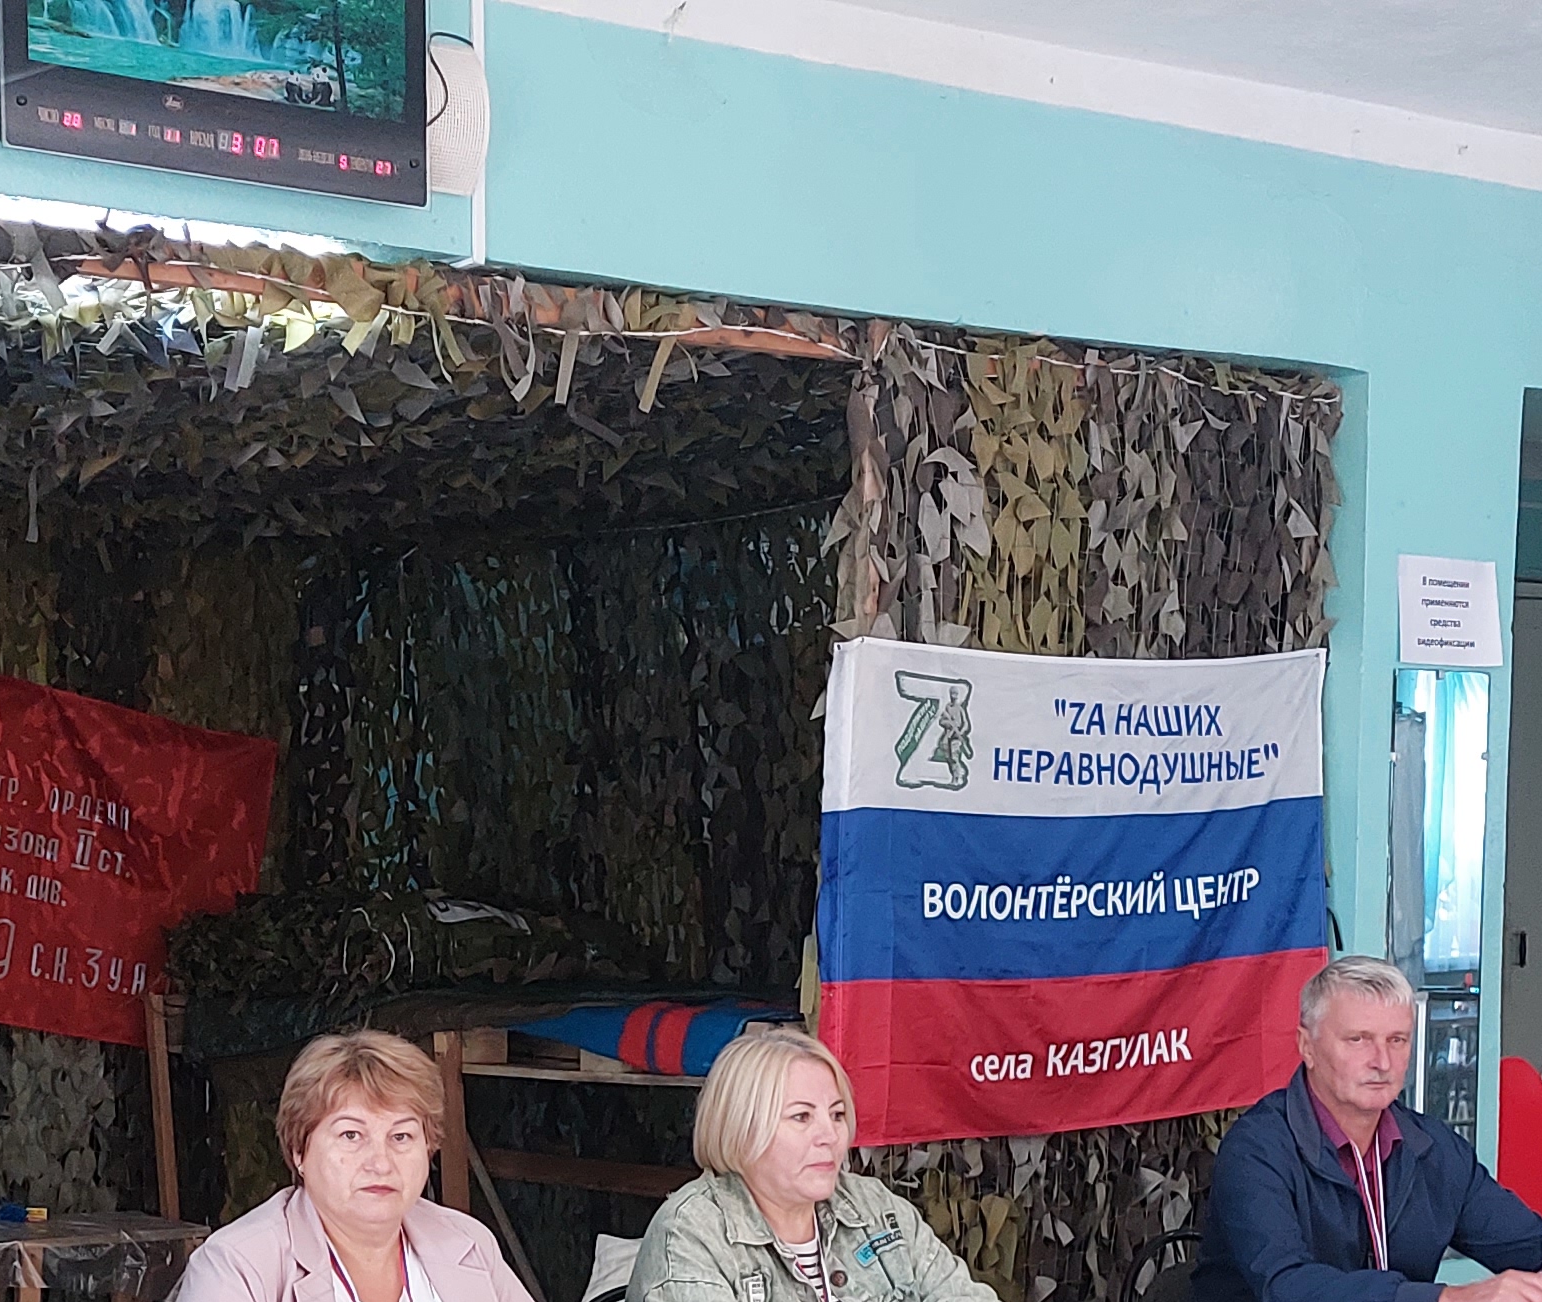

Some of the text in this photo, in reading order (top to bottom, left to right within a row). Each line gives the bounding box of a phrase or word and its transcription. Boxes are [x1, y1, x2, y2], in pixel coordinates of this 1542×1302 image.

[1115, 701, 1223, 738] НАШИХ
[992, 742, 1280, 795] НЕРАВНОДУШНЫЕ"
[922, 866, 1260, 921] ВОЛОНТЁРСКИЙ ЦЕНТР
[970, 1027, 1193, 1083] села КАЗГУЛАК
